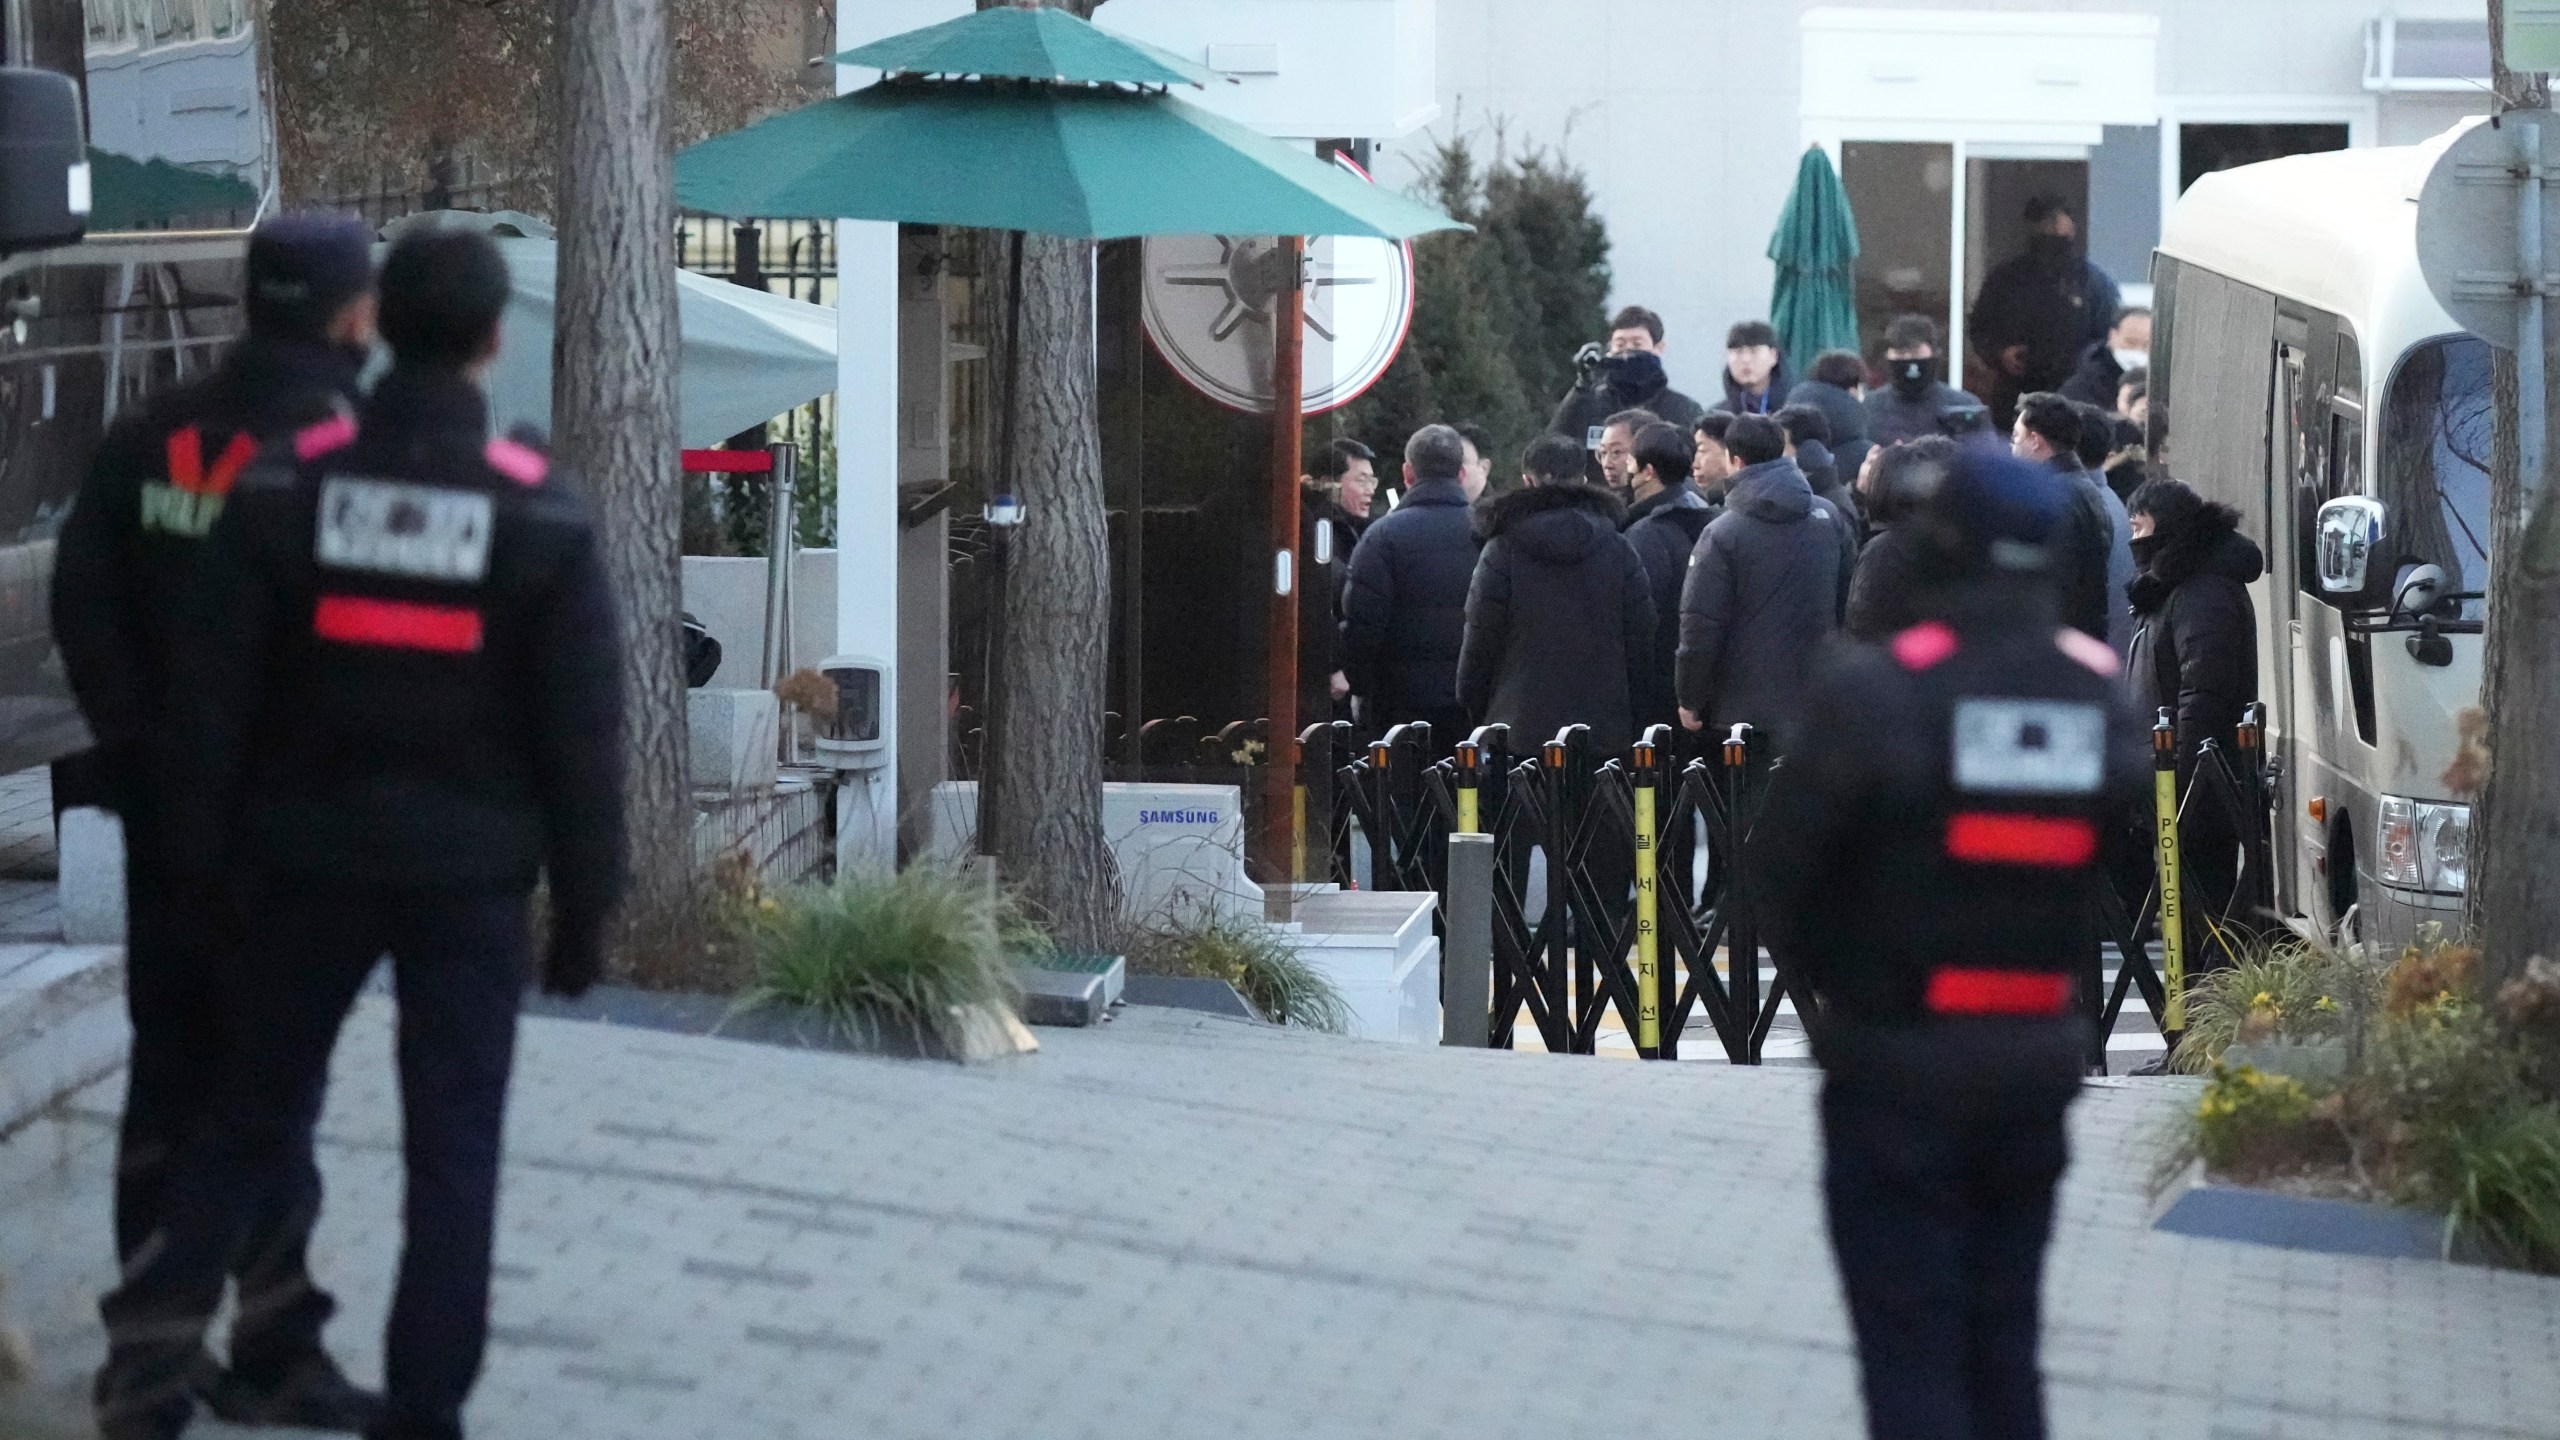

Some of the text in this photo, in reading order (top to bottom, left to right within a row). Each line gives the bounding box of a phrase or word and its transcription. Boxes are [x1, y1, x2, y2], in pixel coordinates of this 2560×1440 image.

[1140, 810, 1218, 824] SAMSUNG
[2161, 818, 2175, 917] POLICE
[1637, 834, 1655, 1021] 질서유지선
